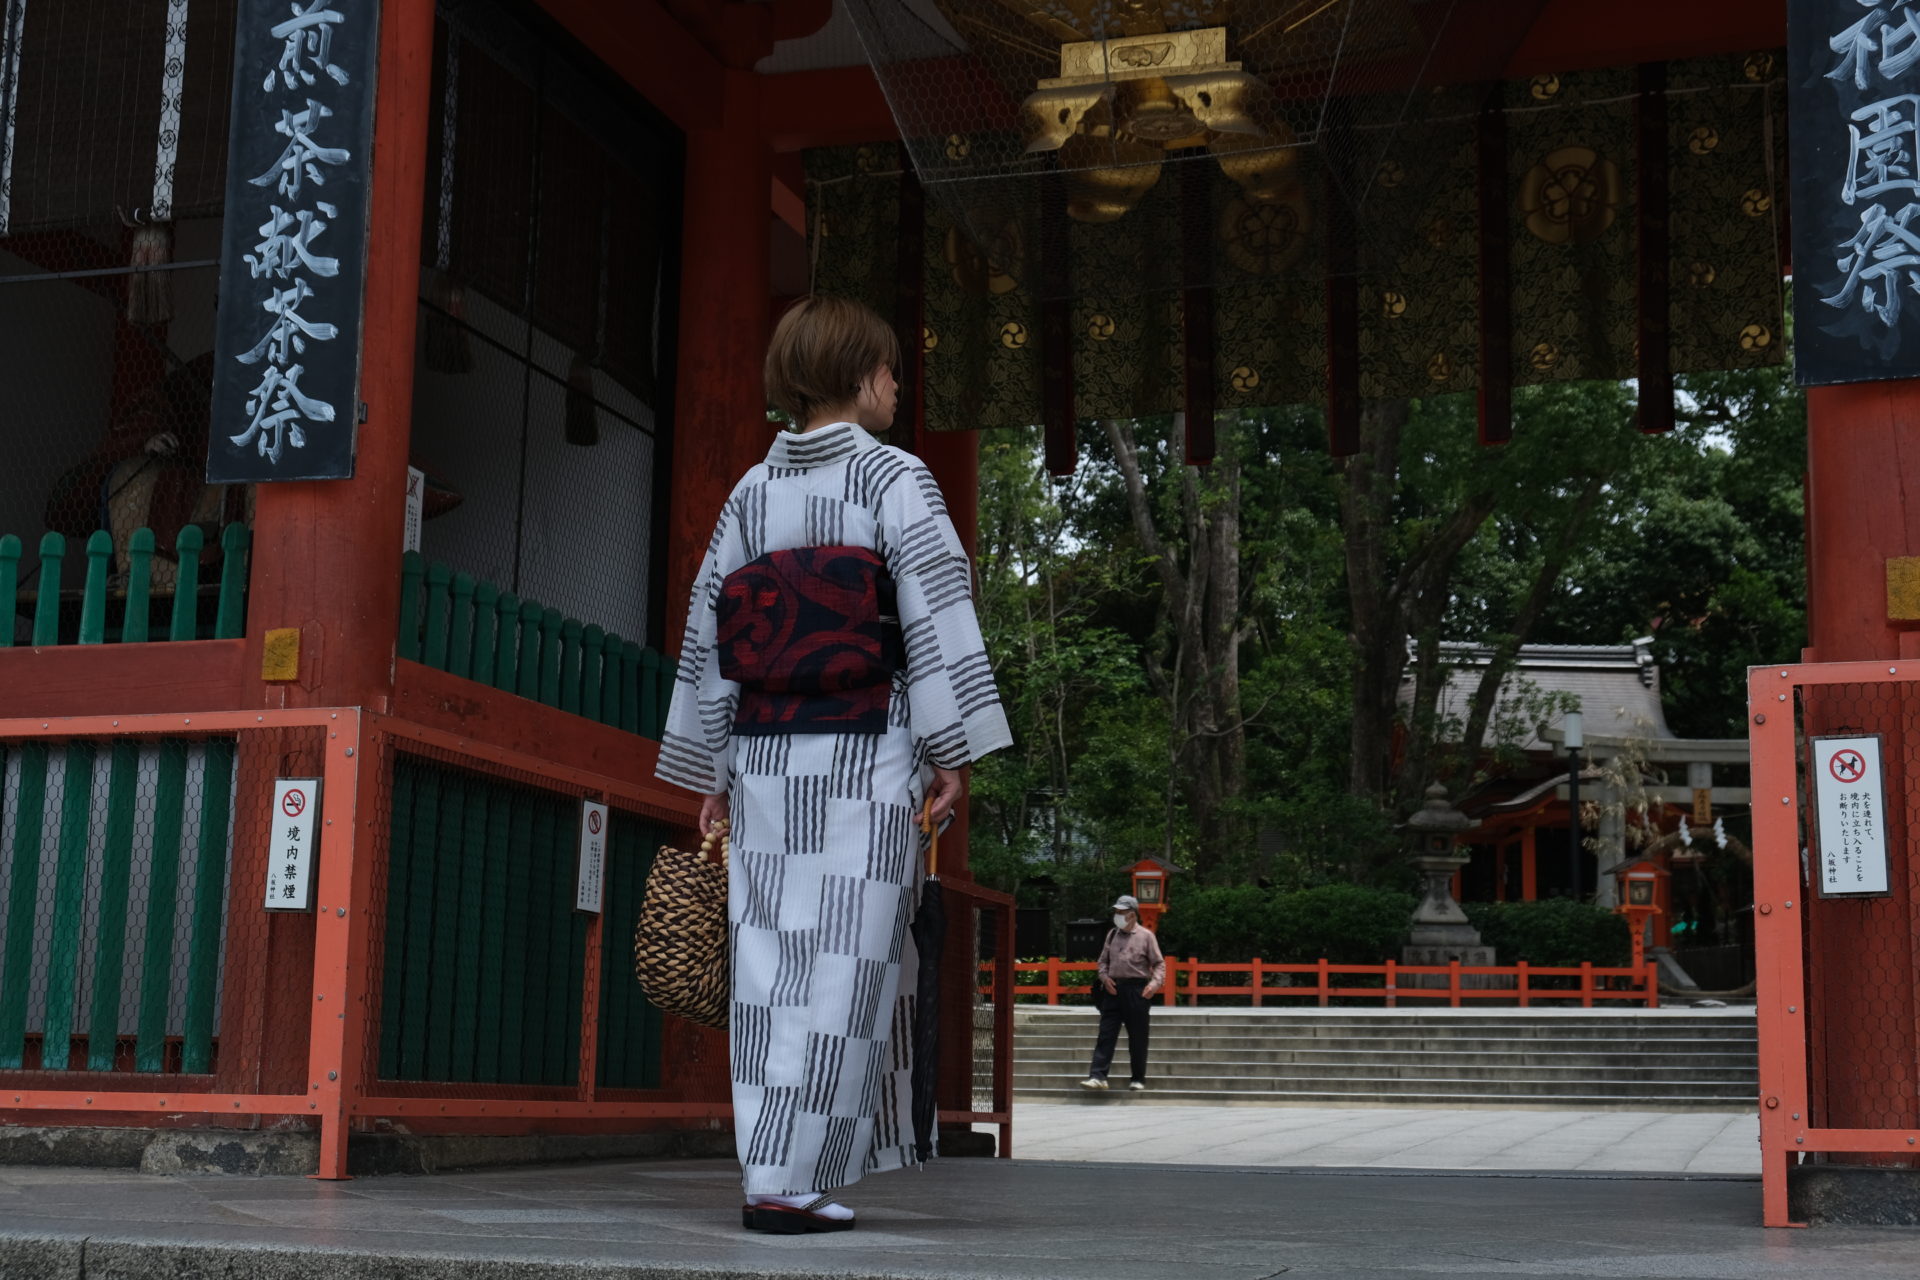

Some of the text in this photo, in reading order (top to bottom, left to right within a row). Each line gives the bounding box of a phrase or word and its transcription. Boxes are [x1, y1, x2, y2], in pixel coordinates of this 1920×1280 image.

[229, 0, 352, 465] 煎茶献茶祭
[1839, 793, 1850, 864] お断りいたします
[1850, 792, 1863, 882] 境内に立ち入ることを
[1862, 792, 1874, 840] 犬を連れて、
[282, 825, 301, 899] 境内禁煙
[1827, 851, 1838, 883] 八坂神社
